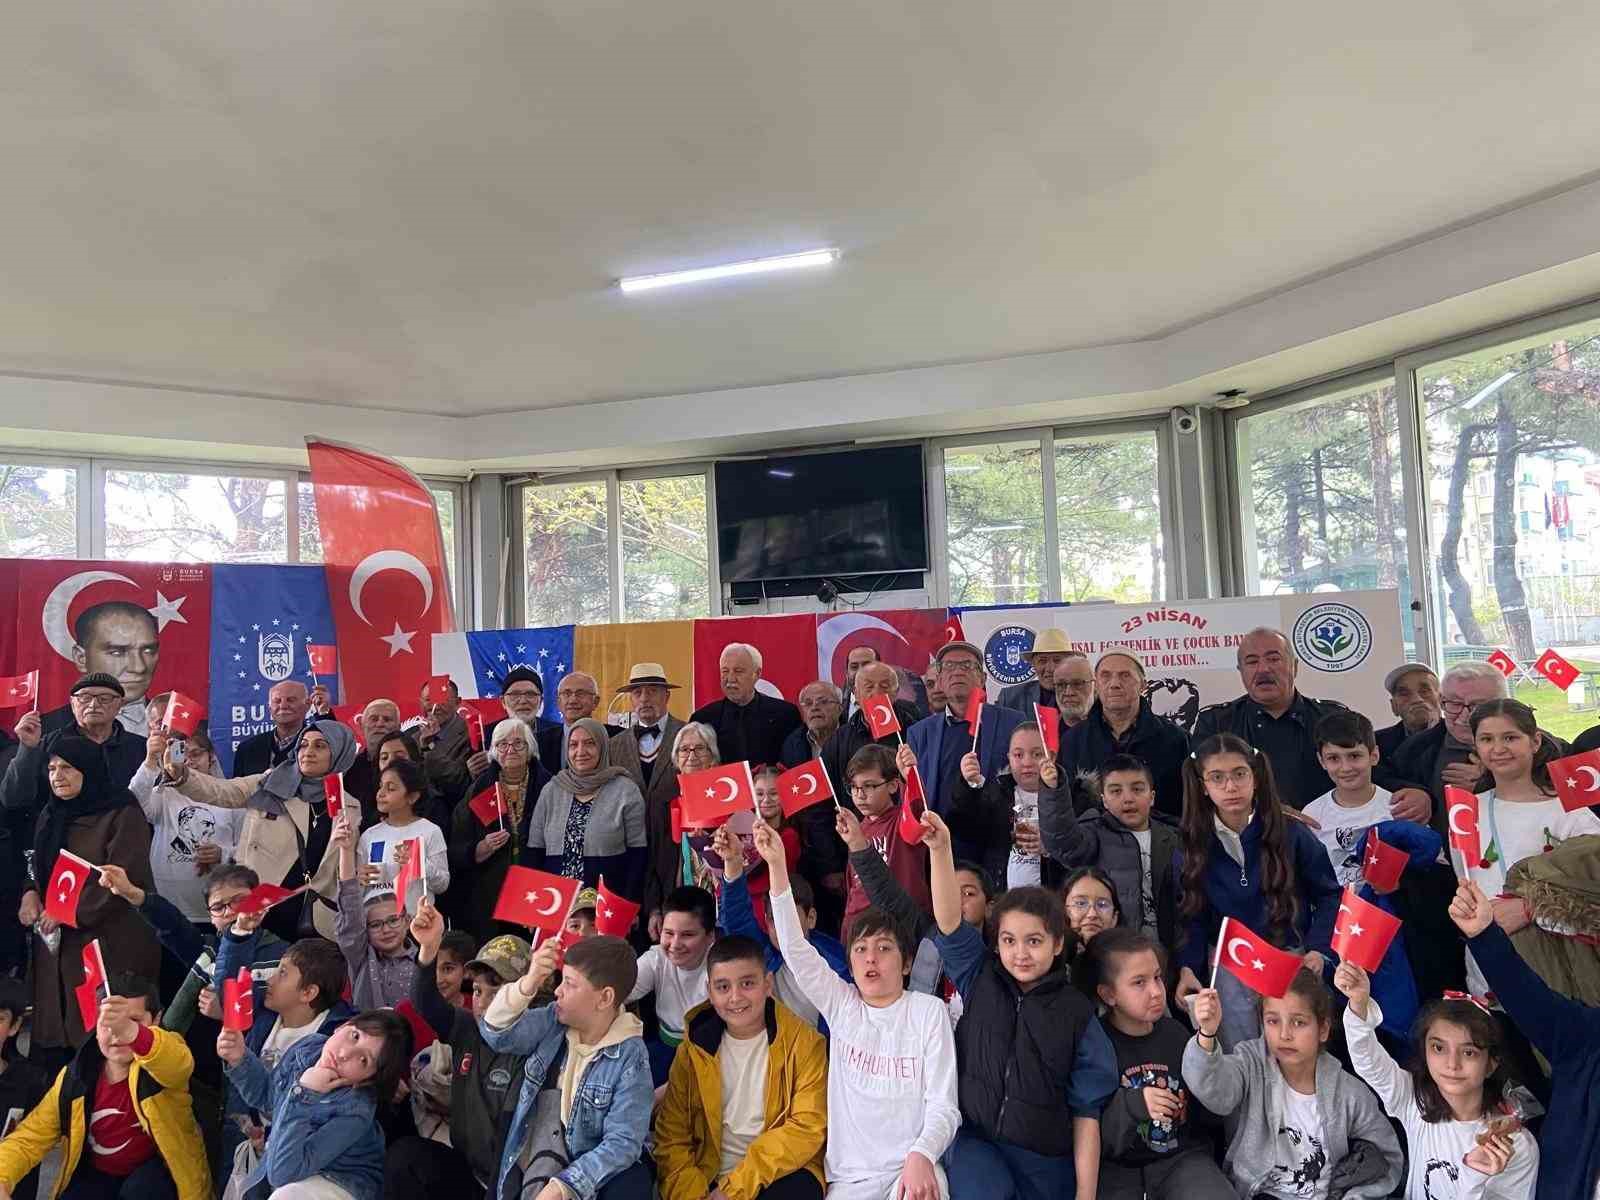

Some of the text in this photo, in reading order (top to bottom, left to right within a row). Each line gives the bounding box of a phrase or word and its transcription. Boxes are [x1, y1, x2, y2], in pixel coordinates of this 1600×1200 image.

[1121, 606, 1207, 634] 23 NİSAN
[1000, 627, 1027, 637] BURSA
[1165, 637, 1179, 650] VE
[1183, 635, 1220, 650] ÇOCUK
